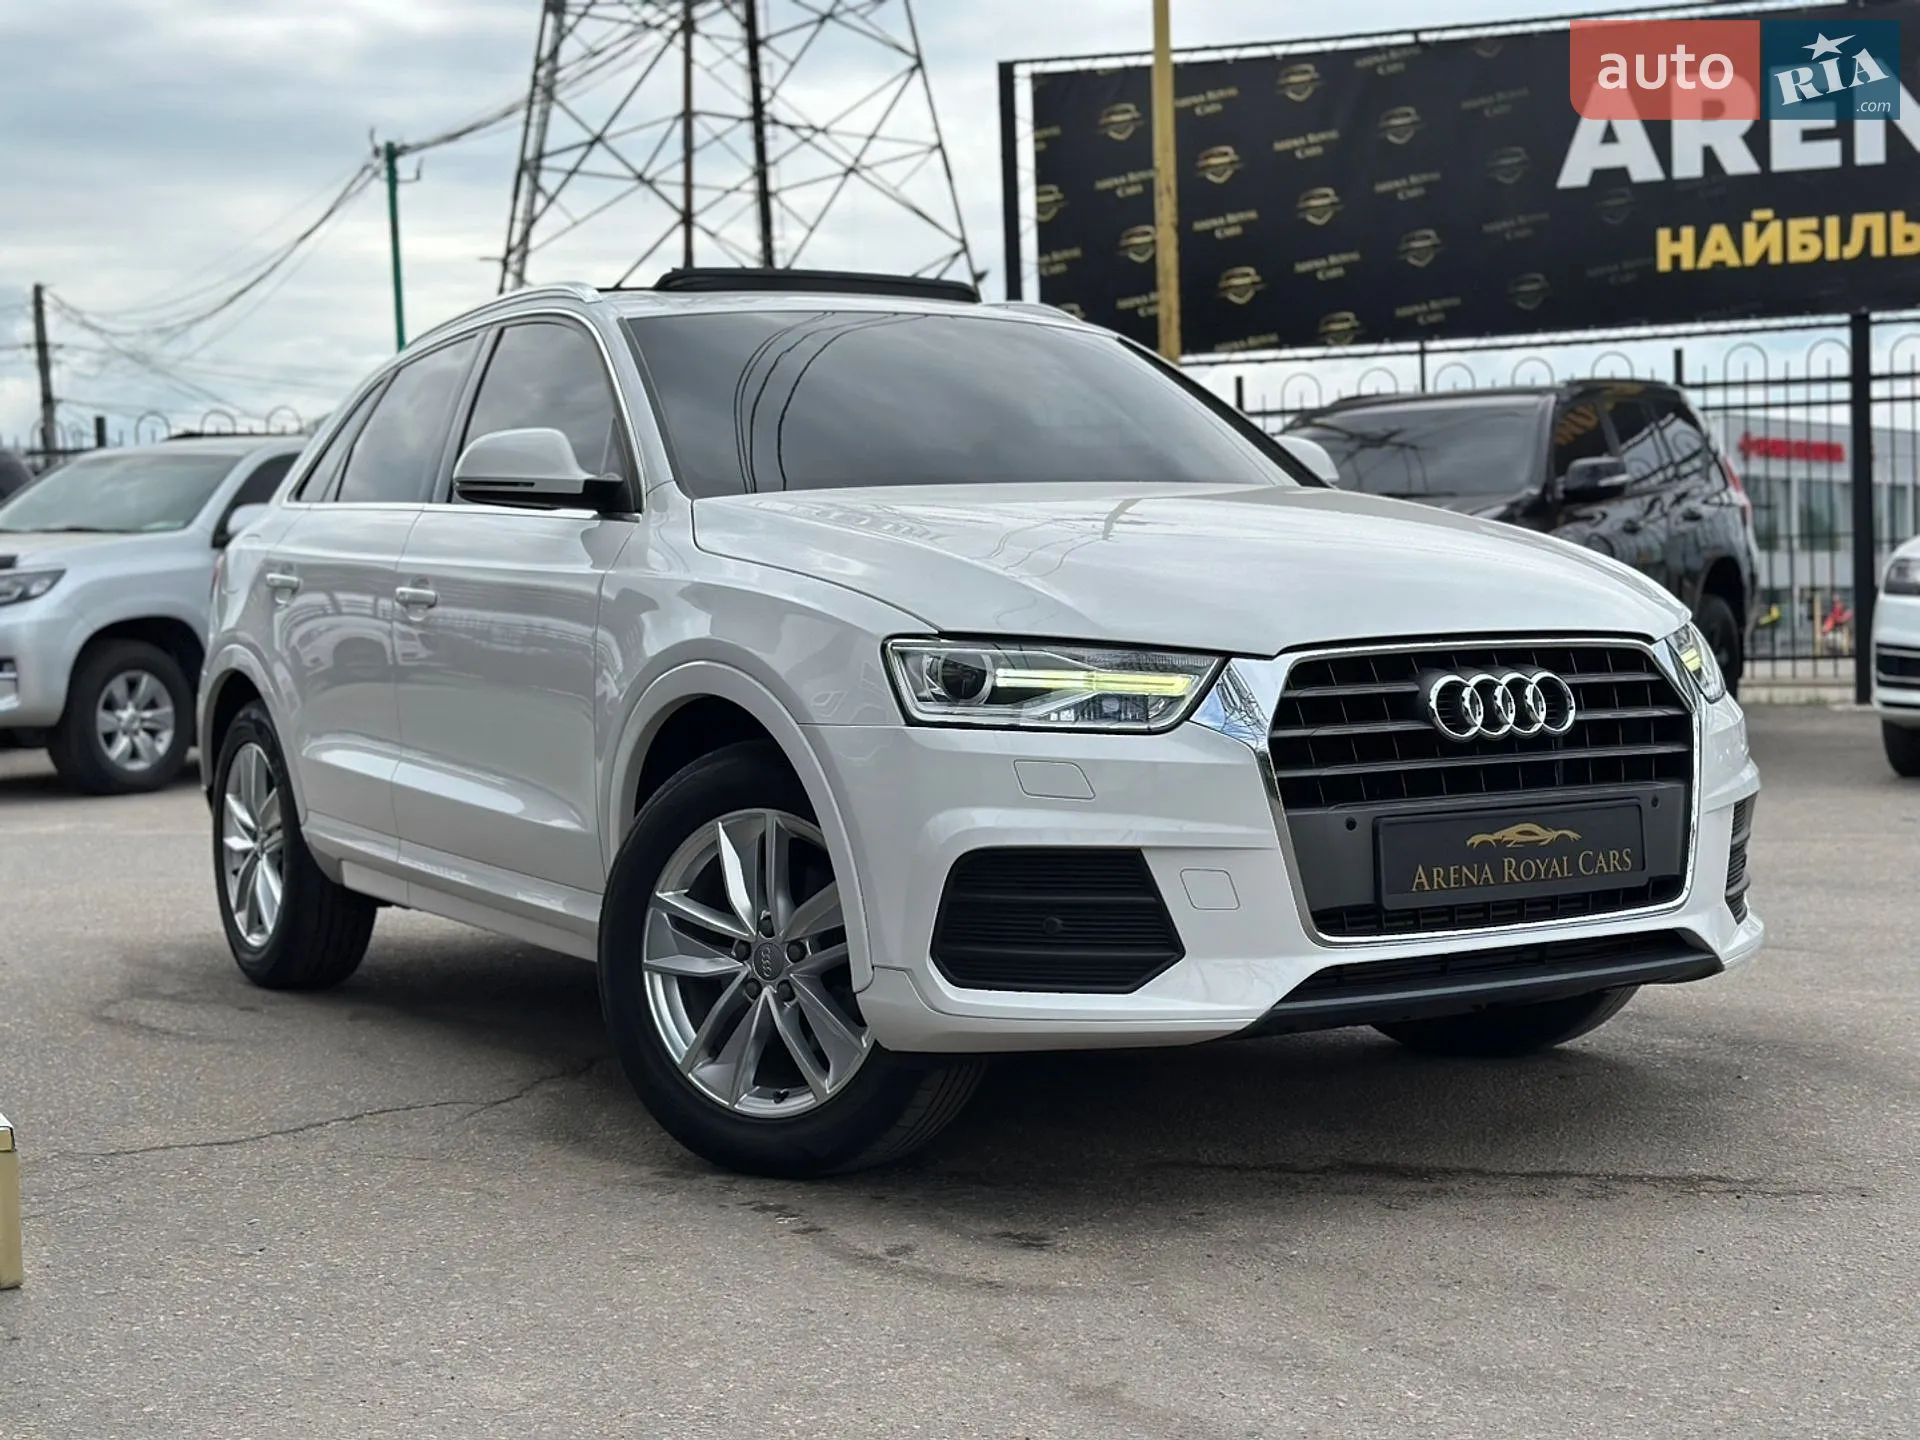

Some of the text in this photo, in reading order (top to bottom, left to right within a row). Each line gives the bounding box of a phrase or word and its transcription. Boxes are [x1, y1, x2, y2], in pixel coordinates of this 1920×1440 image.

[1656, 208, 1920, 273] НАЙБІЛЬ
[1411, 848, 1632, 892] ARENA ROYAL CARS
